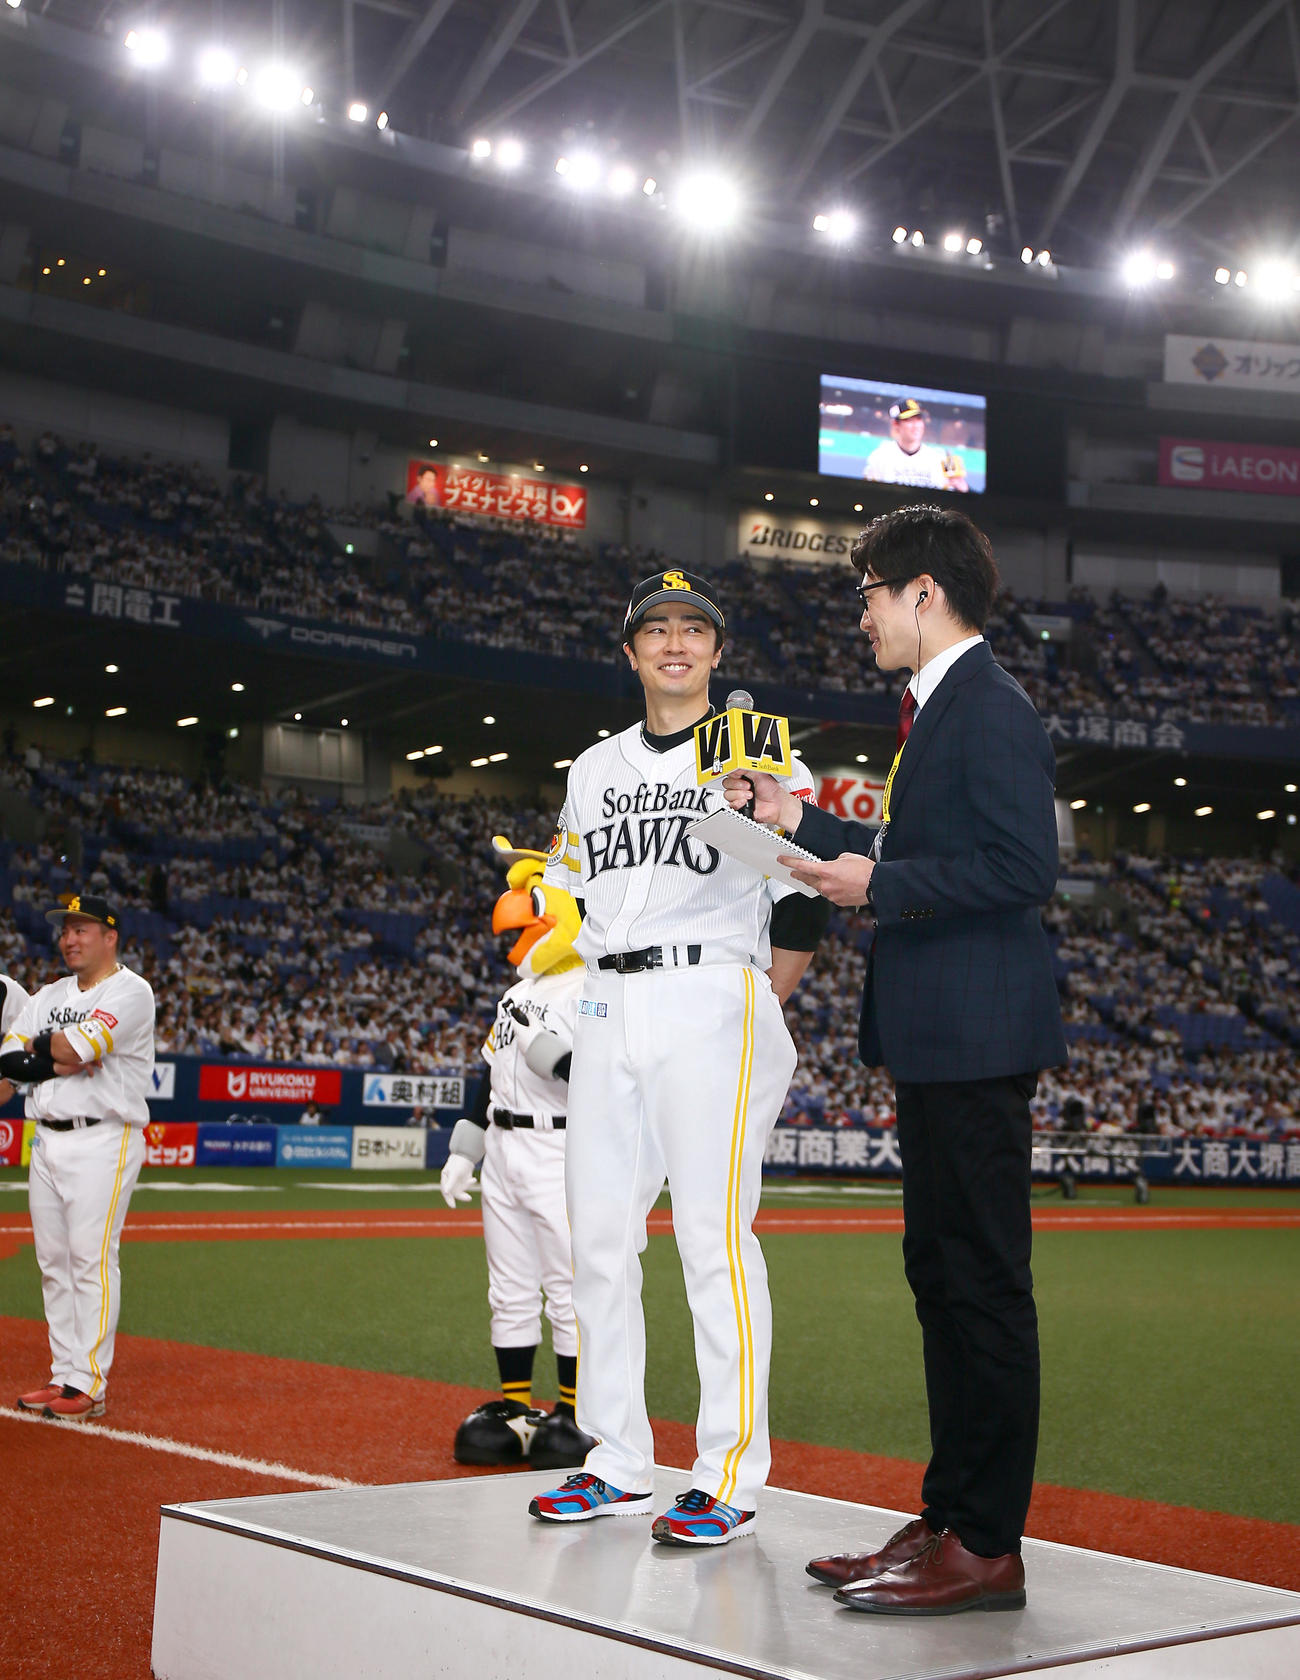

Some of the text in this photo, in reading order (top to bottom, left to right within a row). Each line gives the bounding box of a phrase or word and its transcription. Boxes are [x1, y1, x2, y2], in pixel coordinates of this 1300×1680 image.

[1040, 714, 1184, 749] 大塚商会
[602, 783, 713, 818] SoftBank
[249, 1072, 316, 1087] RYUKOKU
[249, 1087, 314, 1099] UNIVERSITY
[390, 1080, 461, 1105] 奥村組
[357, 1138, 422, 1158] 日本トリム
